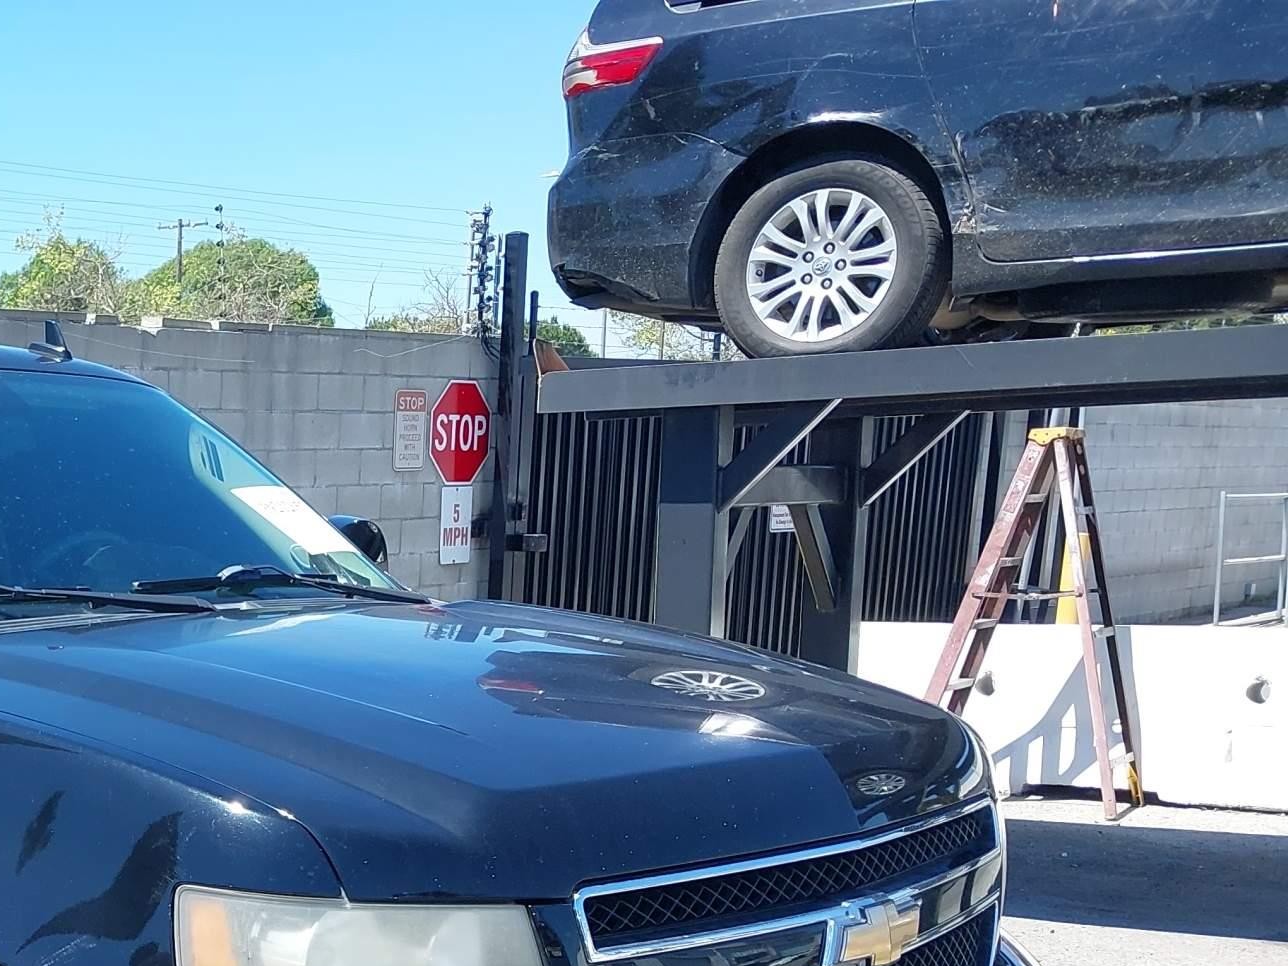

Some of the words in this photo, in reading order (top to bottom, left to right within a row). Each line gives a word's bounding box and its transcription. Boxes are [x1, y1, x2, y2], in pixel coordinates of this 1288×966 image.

[399, 397, 425, 410] STOP
[434, 413, 487, 452] STOP
[453, 503, 460, 523] 5
[442, 527, 469, 547] MPH
